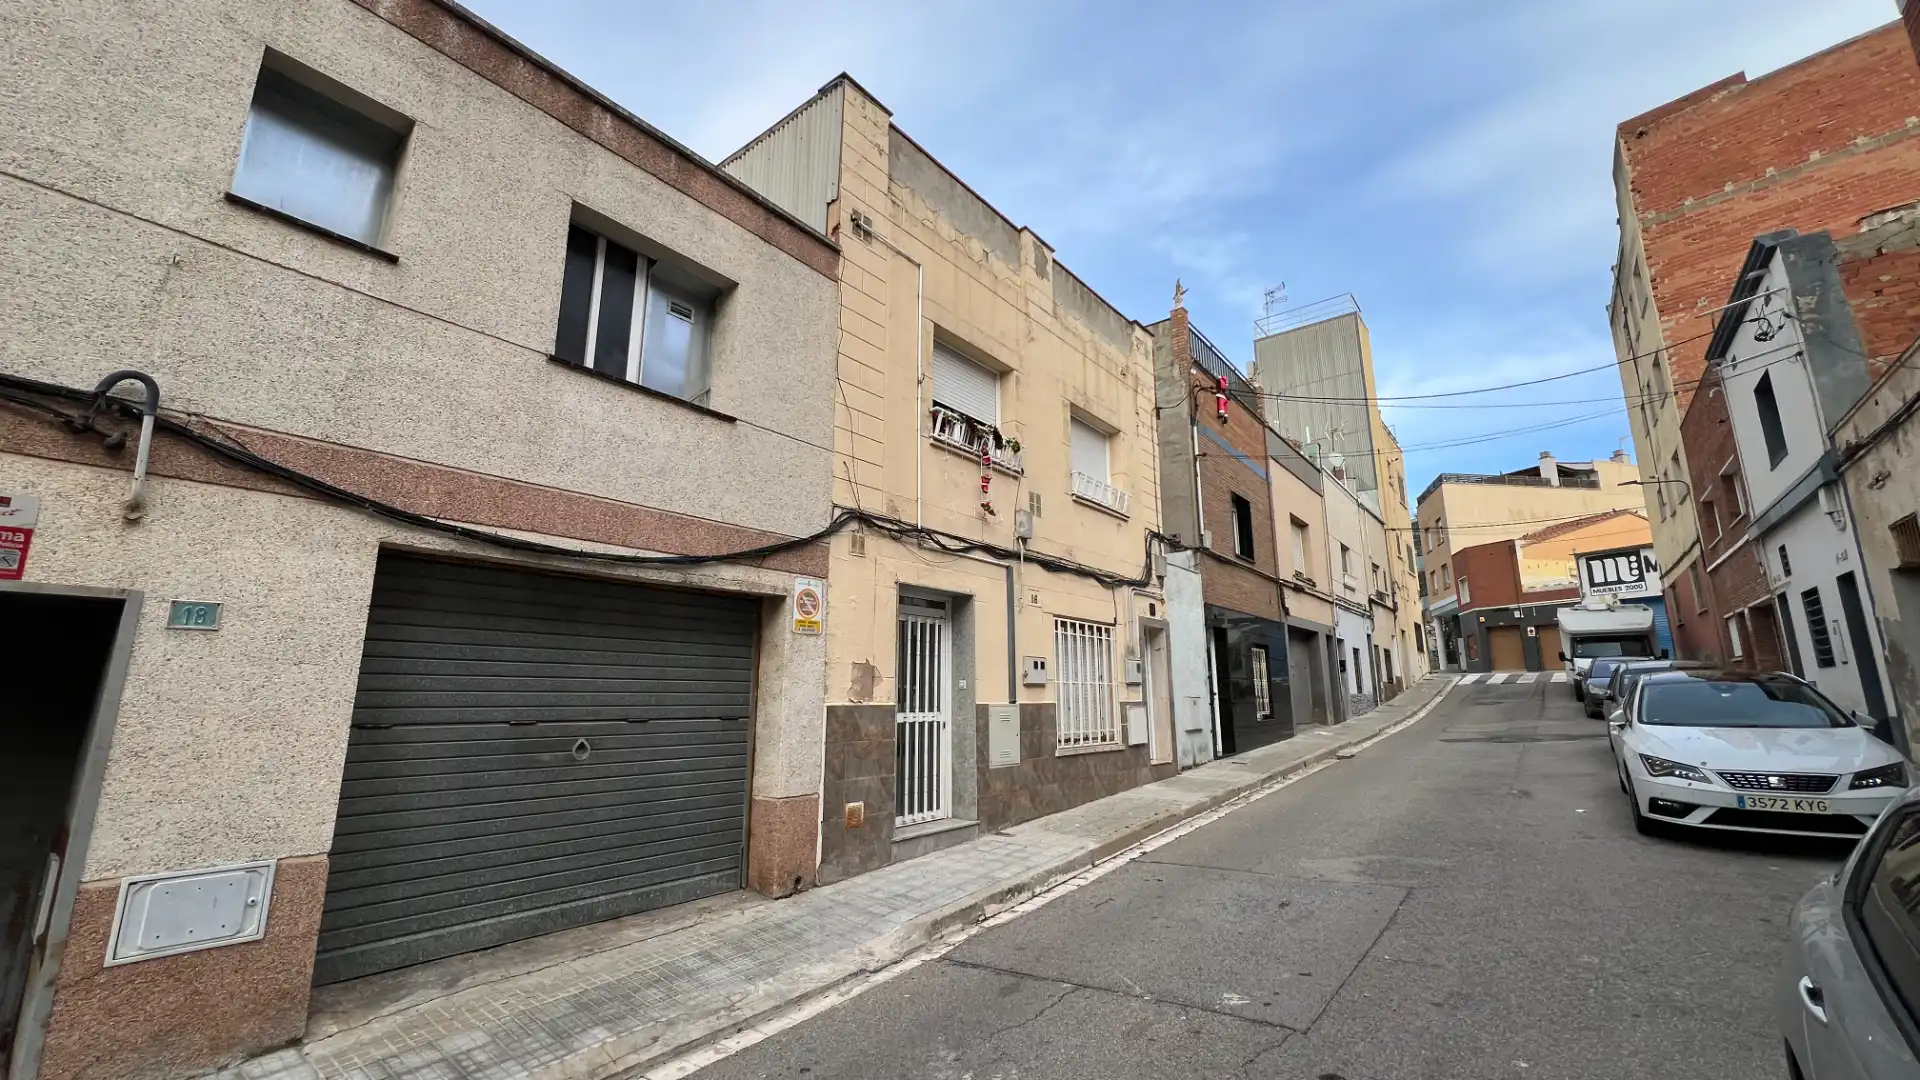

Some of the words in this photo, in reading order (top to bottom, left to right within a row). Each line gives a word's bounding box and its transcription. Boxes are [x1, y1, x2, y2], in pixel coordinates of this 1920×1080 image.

[1625, 583, 1644, 591] 2000
[181, 605, 207, 625] 18
[1747, 797, 1789, 810] 3572
[1794, 799, 1828, 812] KYG
